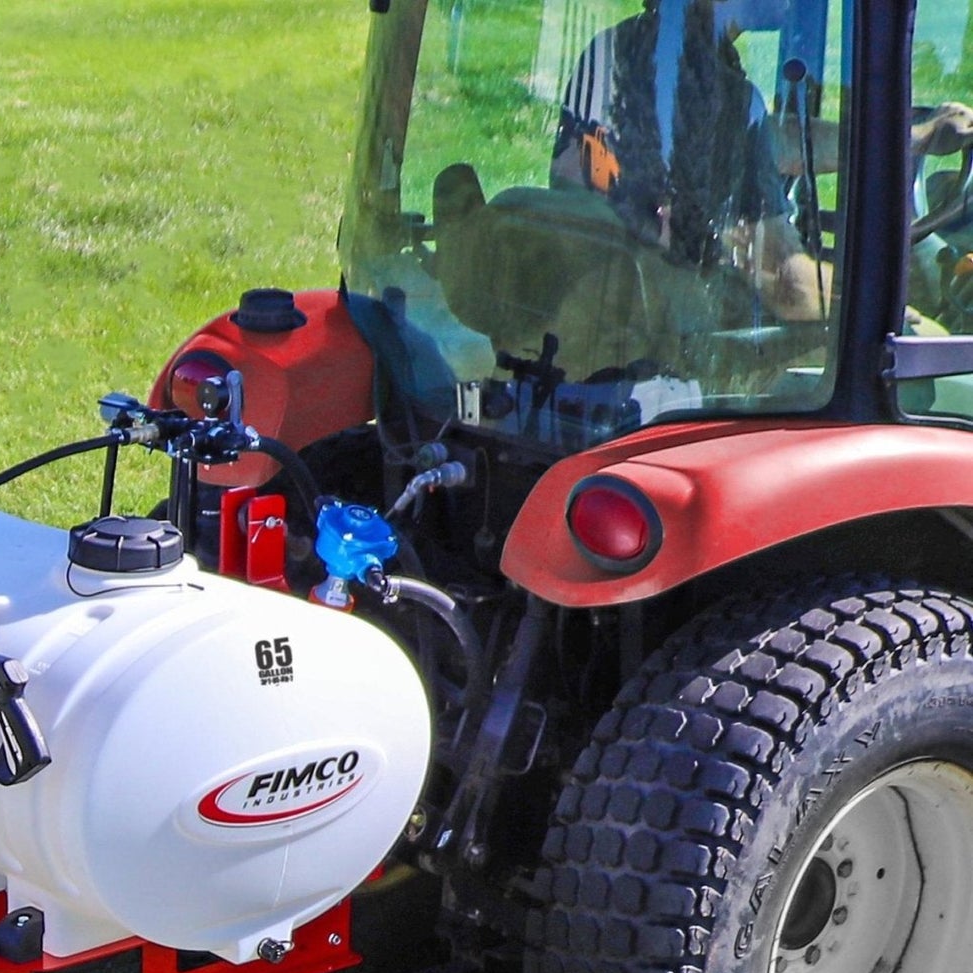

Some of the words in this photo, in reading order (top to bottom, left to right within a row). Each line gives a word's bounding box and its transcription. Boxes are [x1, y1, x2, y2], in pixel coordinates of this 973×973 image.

[255, 636, 293, 670] 65
[258, 666, 294, 679] GALLON
[242, 773, 356, 810] INDUSTRIES
[247, 750, 360, 799] FIMCO
[733, 719, 883, 960] GALAXY
